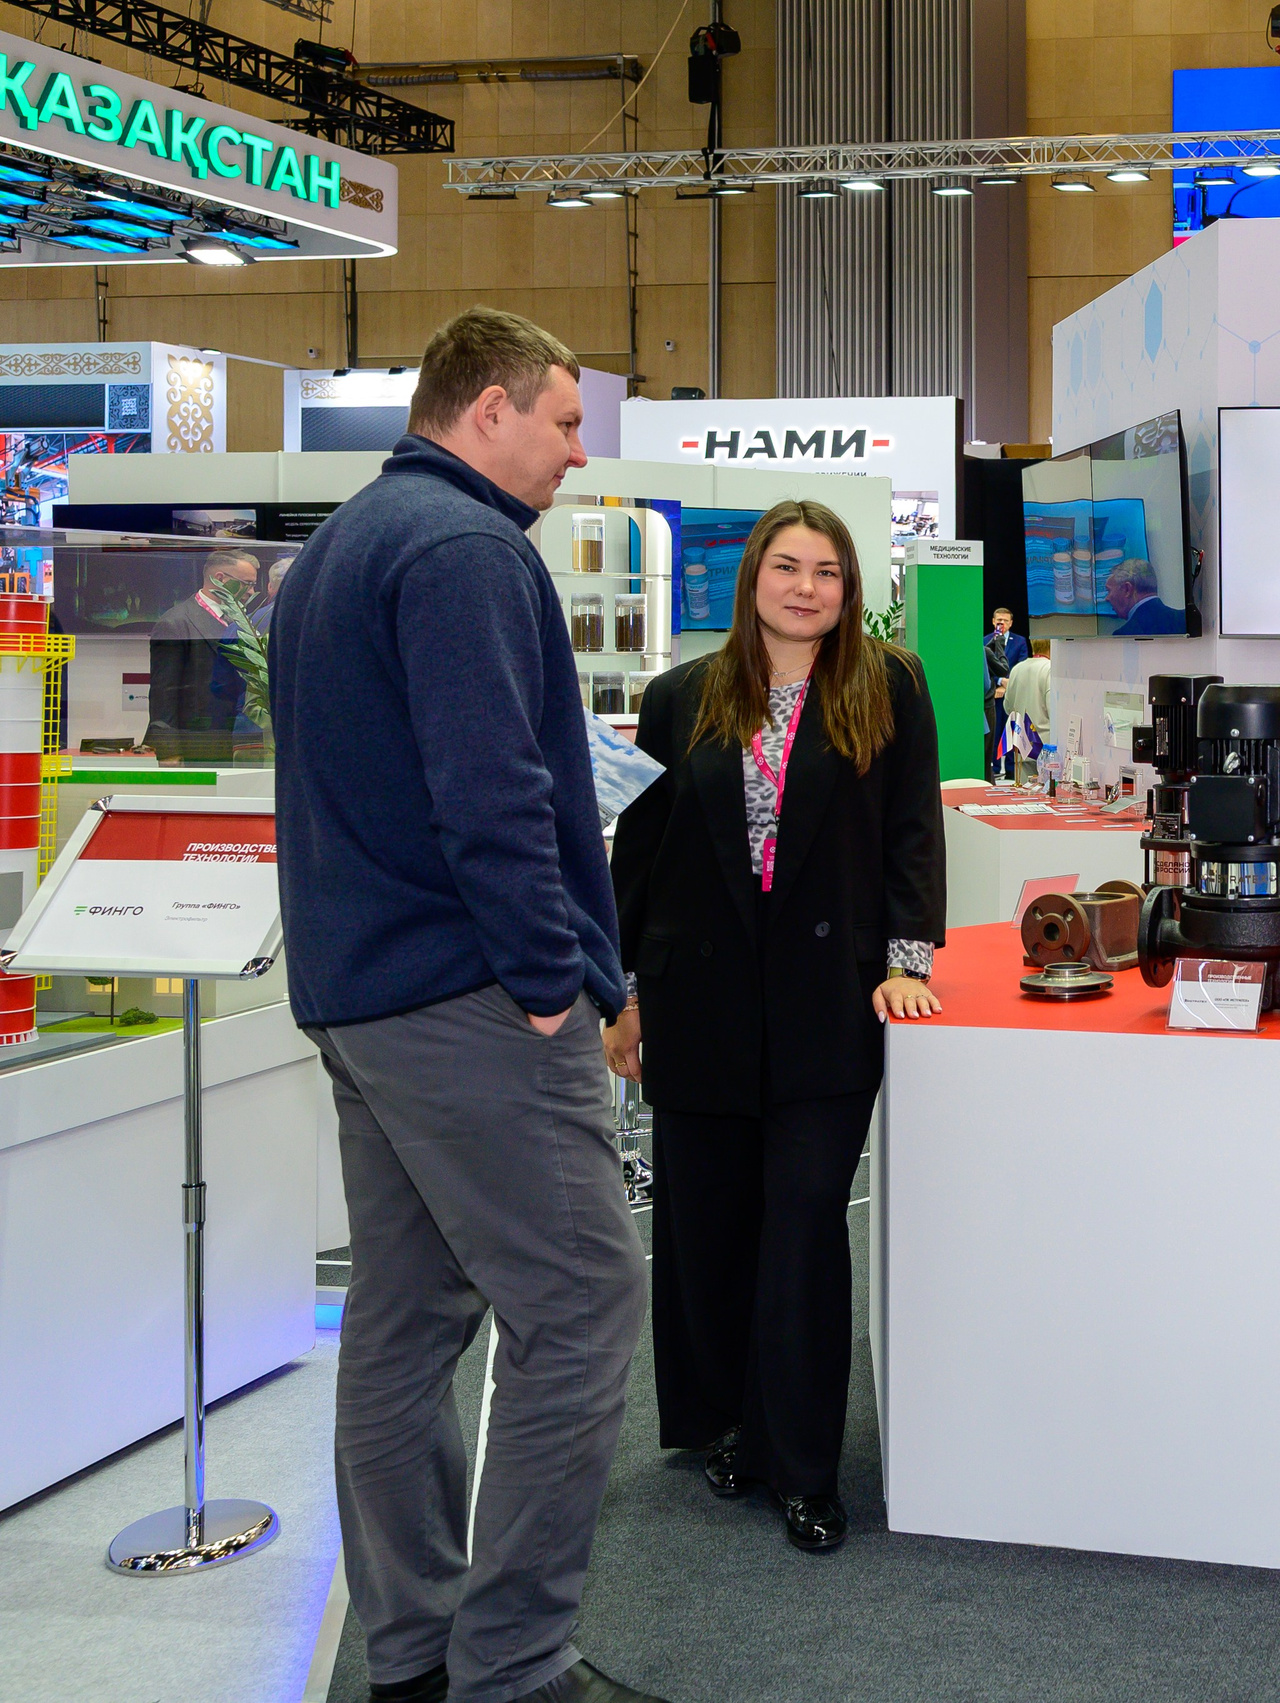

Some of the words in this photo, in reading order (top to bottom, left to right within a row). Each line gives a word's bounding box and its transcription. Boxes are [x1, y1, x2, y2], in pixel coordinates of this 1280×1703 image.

[0, 52, 341, 209] ҚАЗАҚСТАН
[705, 430, 867, 458] НАМИ
[186, 843, 277, 853] ПРОИЗВОДСТВЕ
[182, 853, 259, 863] ТЕХНОЛОГИИ
[89, 906, 144, 916] ФИНГО
